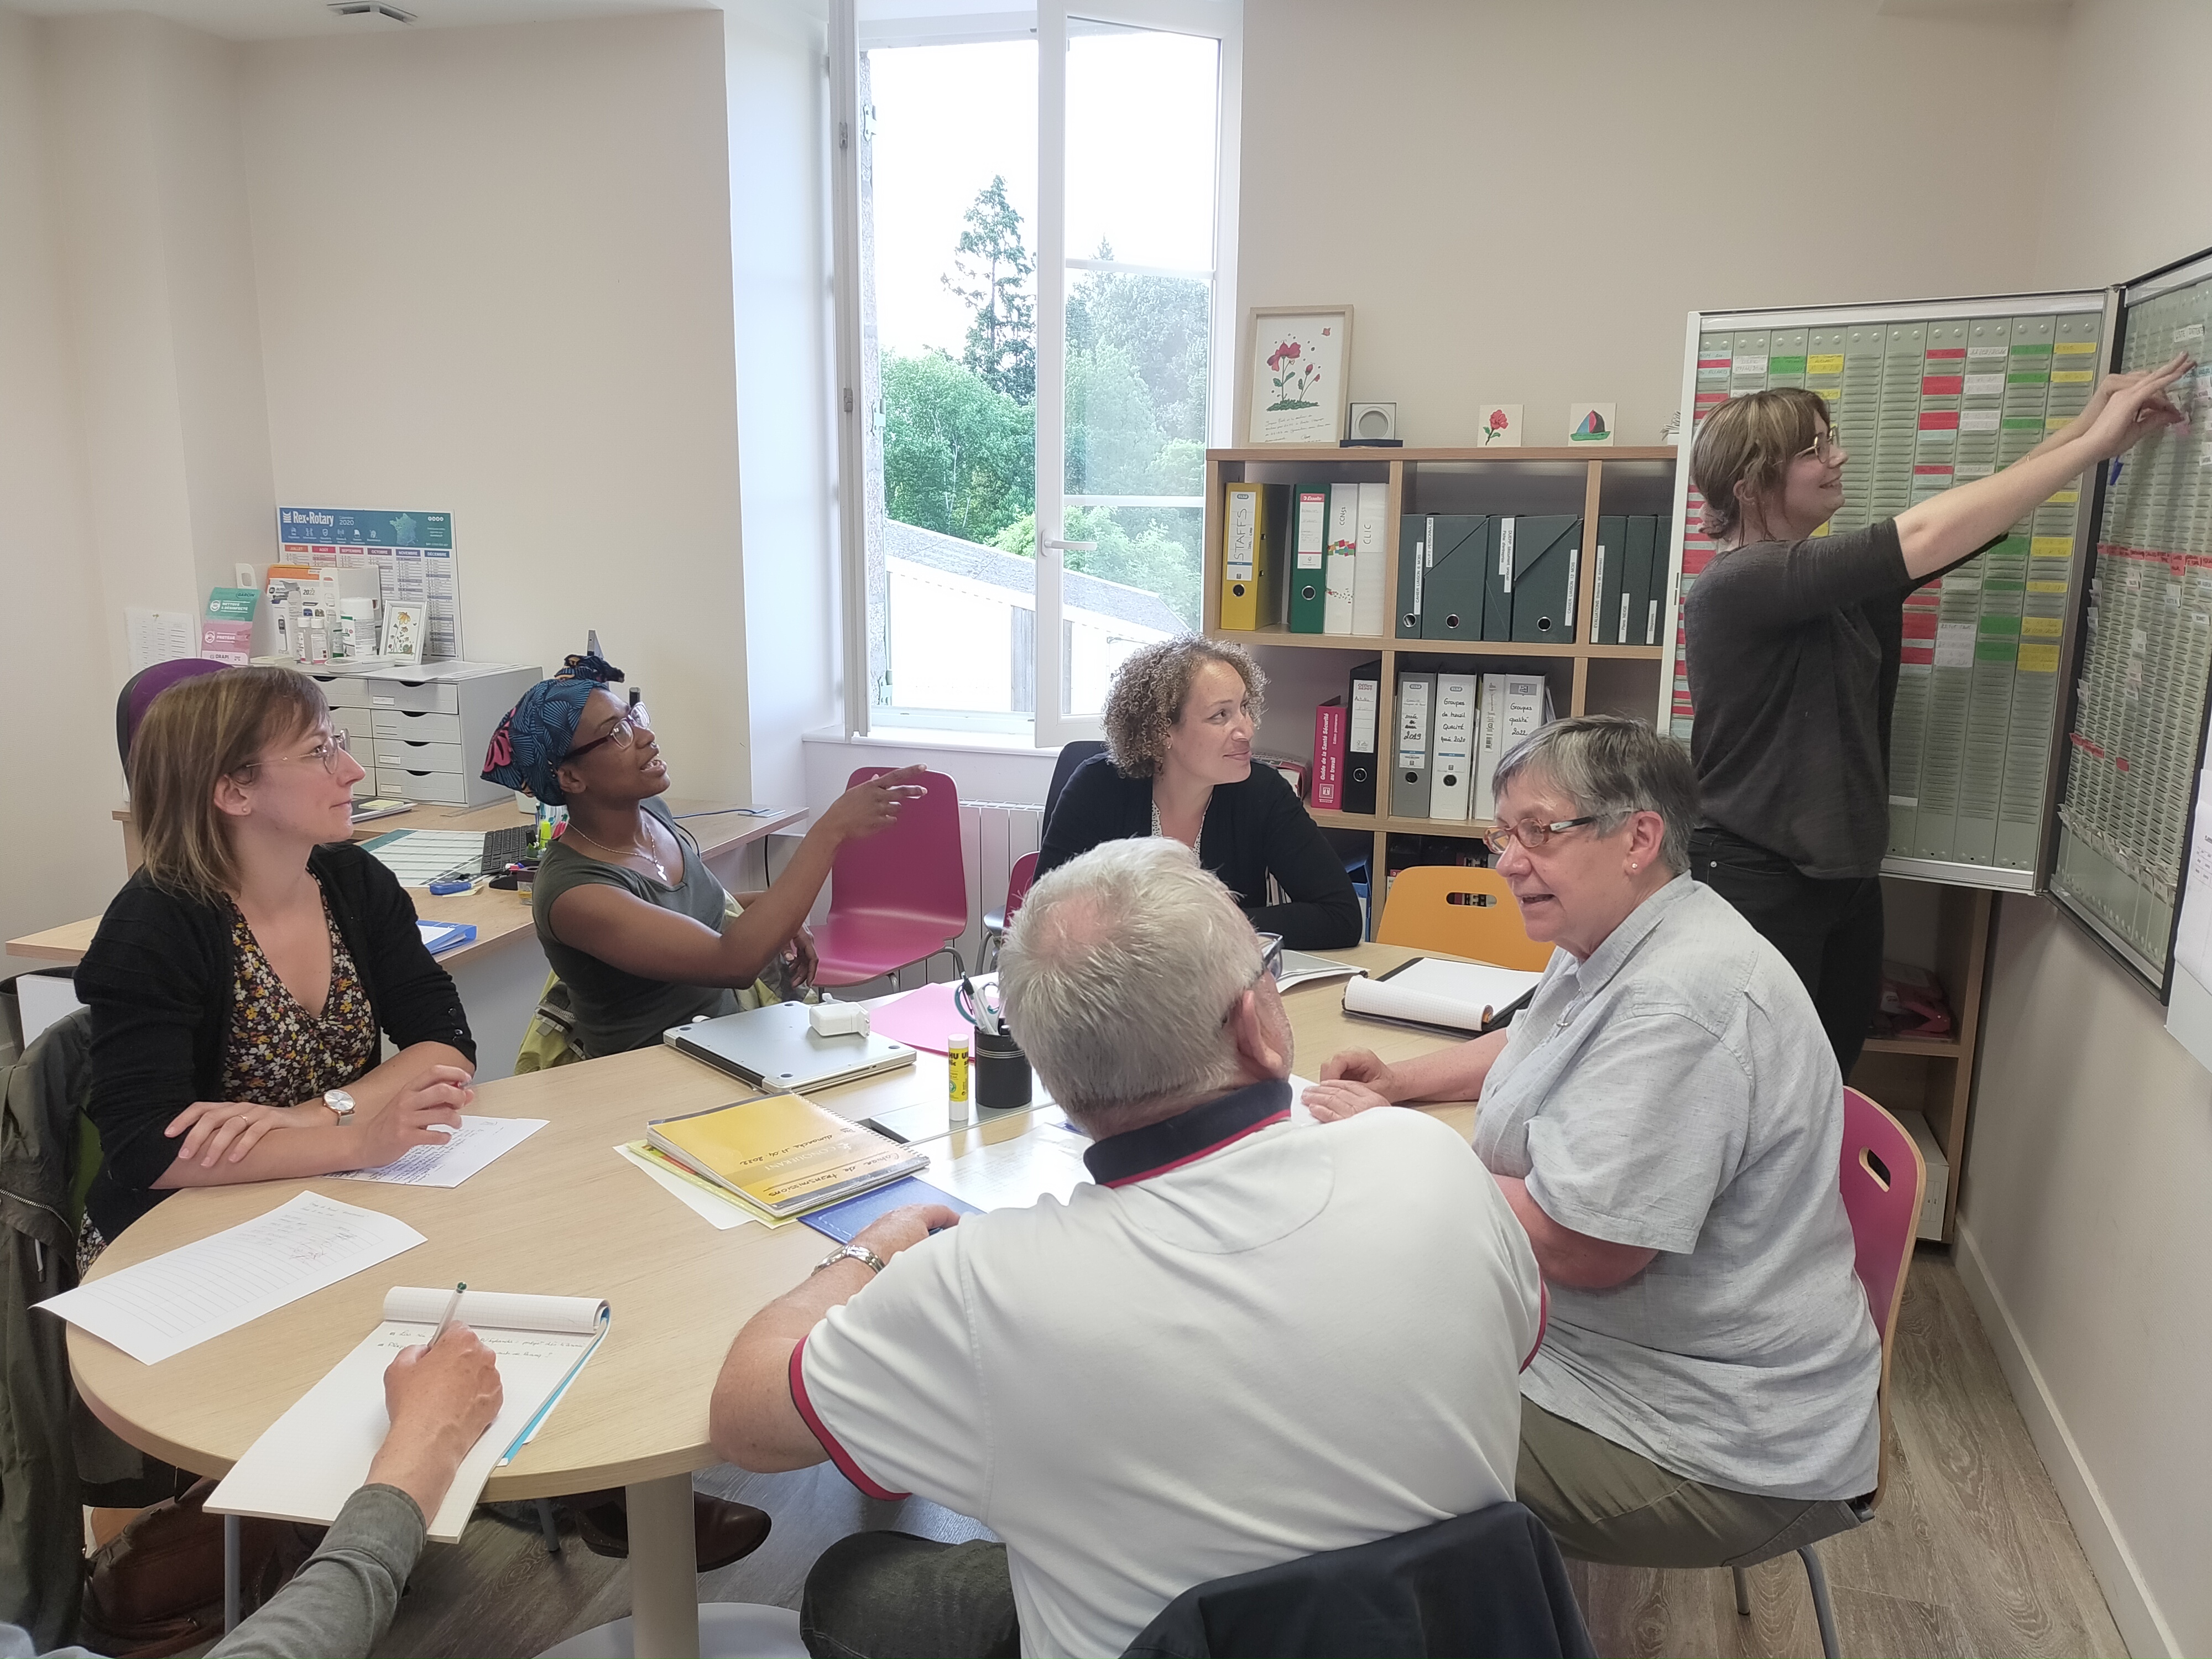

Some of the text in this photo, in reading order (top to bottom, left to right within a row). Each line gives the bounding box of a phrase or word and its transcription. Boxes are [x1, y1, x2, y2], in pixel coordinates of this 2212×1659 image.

[1339, 506, 1347, 526] CCN51
[1234, 508, 1247, 561] STAFFS
[1363, 523, 1372, 545] CLIC
[1444, 698, 1465, 707] Groupes
[1510, 702, 1532, 713] Groupes
[1509, 717, 1529, 726] qualité
[1404, 731, 1421, 740] 2019
[793, 1134, 833, 1148] dimanche
[768, 1173, 838, 1197] transmissions
